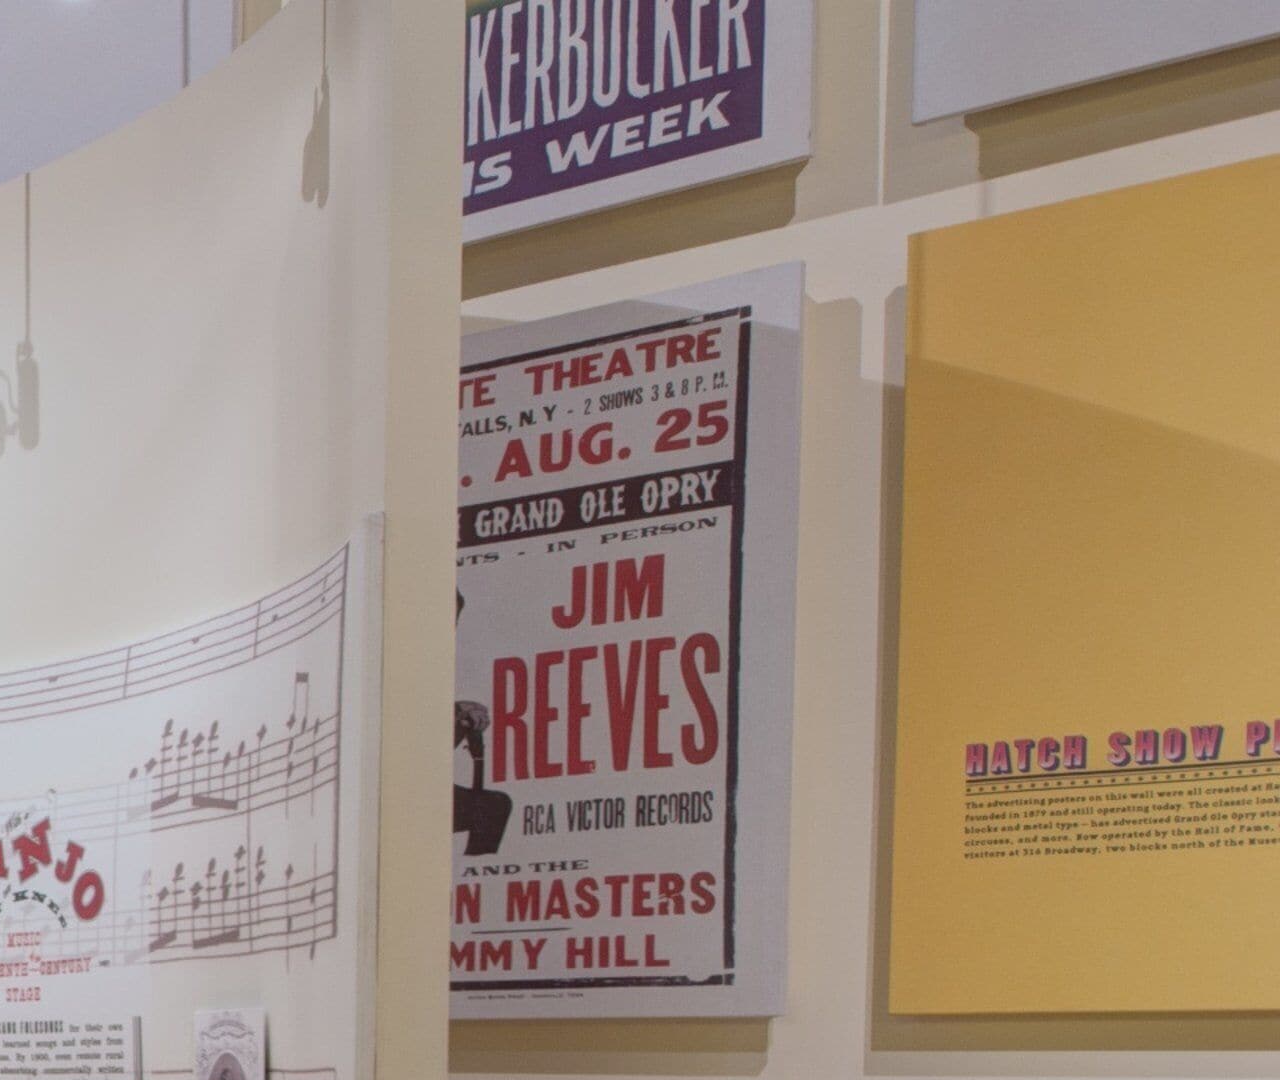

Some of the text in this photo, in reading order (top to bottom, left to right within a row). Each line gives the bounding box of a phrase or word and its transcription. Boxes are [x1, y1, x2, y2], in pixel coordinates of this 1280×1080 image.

[545, 91, 732, 174] WEEK
[524, 327, 722, 396] THEATRE
[458, 414, 513, 438] ALLS,
[543, 404, 557, 421] Y
[583, 398, 593, 416] 2
[600, 387, 644, 412] SHOWS
[651, 383, 660, 401] 3
[665, 382, 676, 399] &
[681, 378, 690, 396] 8
[494, 400, 730, 482] AUG. 25
[474, 469, 721, 538] GRAND OLE OPRY
[547, 539, 577, 553] IN
[600, 516, 719, 545] PERSON
[551, 553, 665, 630] JIM
[493, 632, 720, 784] REEVES
[965, 735, 1089, 778] HATCH
[1106, 723, 1224, 767] SHOW
[523, 789, 715, 836] RCA VICTOR RECORDS
[964, 812, 1209, 835] blocks Grand
[965, 784, 1249, 812] The posters created
[1097, 802, 1150, 816] operating
[1189, 799, 1209, 810] The
[462, 858, 590, 878] AND THE
[1130, 840, 1168, 853] blocks
[1171, 837, 1205, 851] north
[505, 870, 717, 922] MASTERS
[565, 933, 671, 969] HILL
